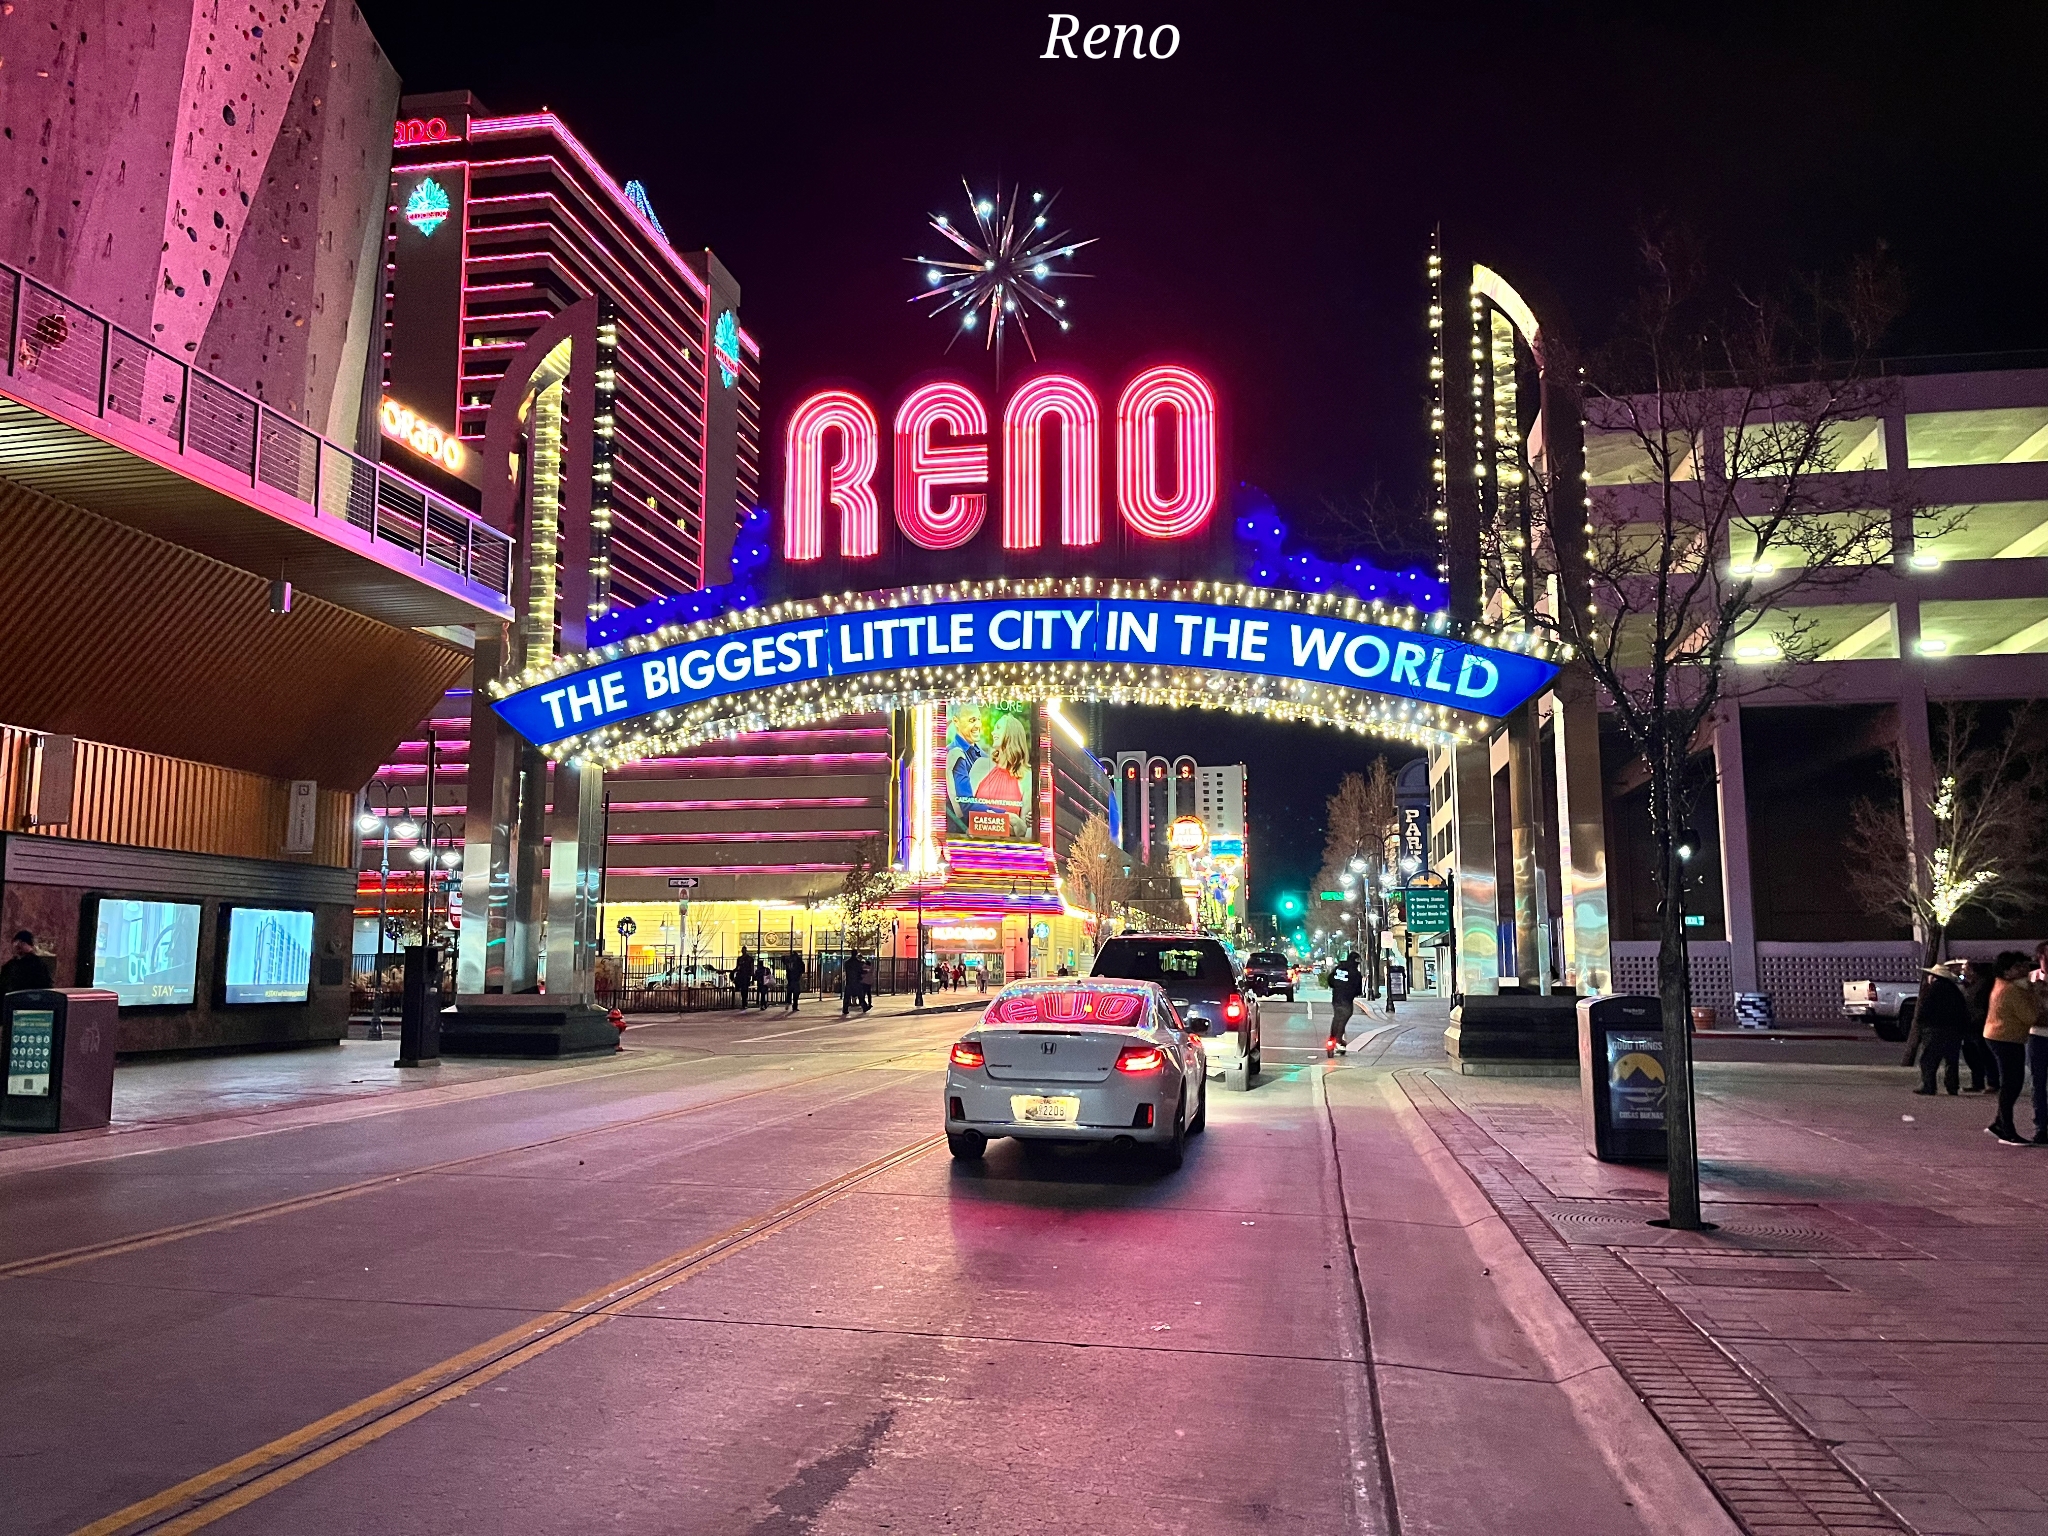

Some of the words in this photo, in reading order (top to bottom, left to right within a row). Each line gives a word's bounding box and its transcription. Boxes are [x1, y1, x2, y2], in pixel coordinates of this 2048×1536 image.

[541, 671, 628, 729] THE
[641, 627, 825, 700] BIGGEST
[839, 612, 974, 664] LITTLE
[988, 609, 1095, 652] CITY
[1105, 610, 1157, 653] IN
[1174, 614, 1269, 663] THE
[1291, 627, 1500, 699] WORLD
[973, 816, 1006, 825] CAESARS
[974, 824, 1006, 832] REWARDS
[152, 985, 175, 997] STAY
[1635, 1041, 1663, 1051] THINGS
